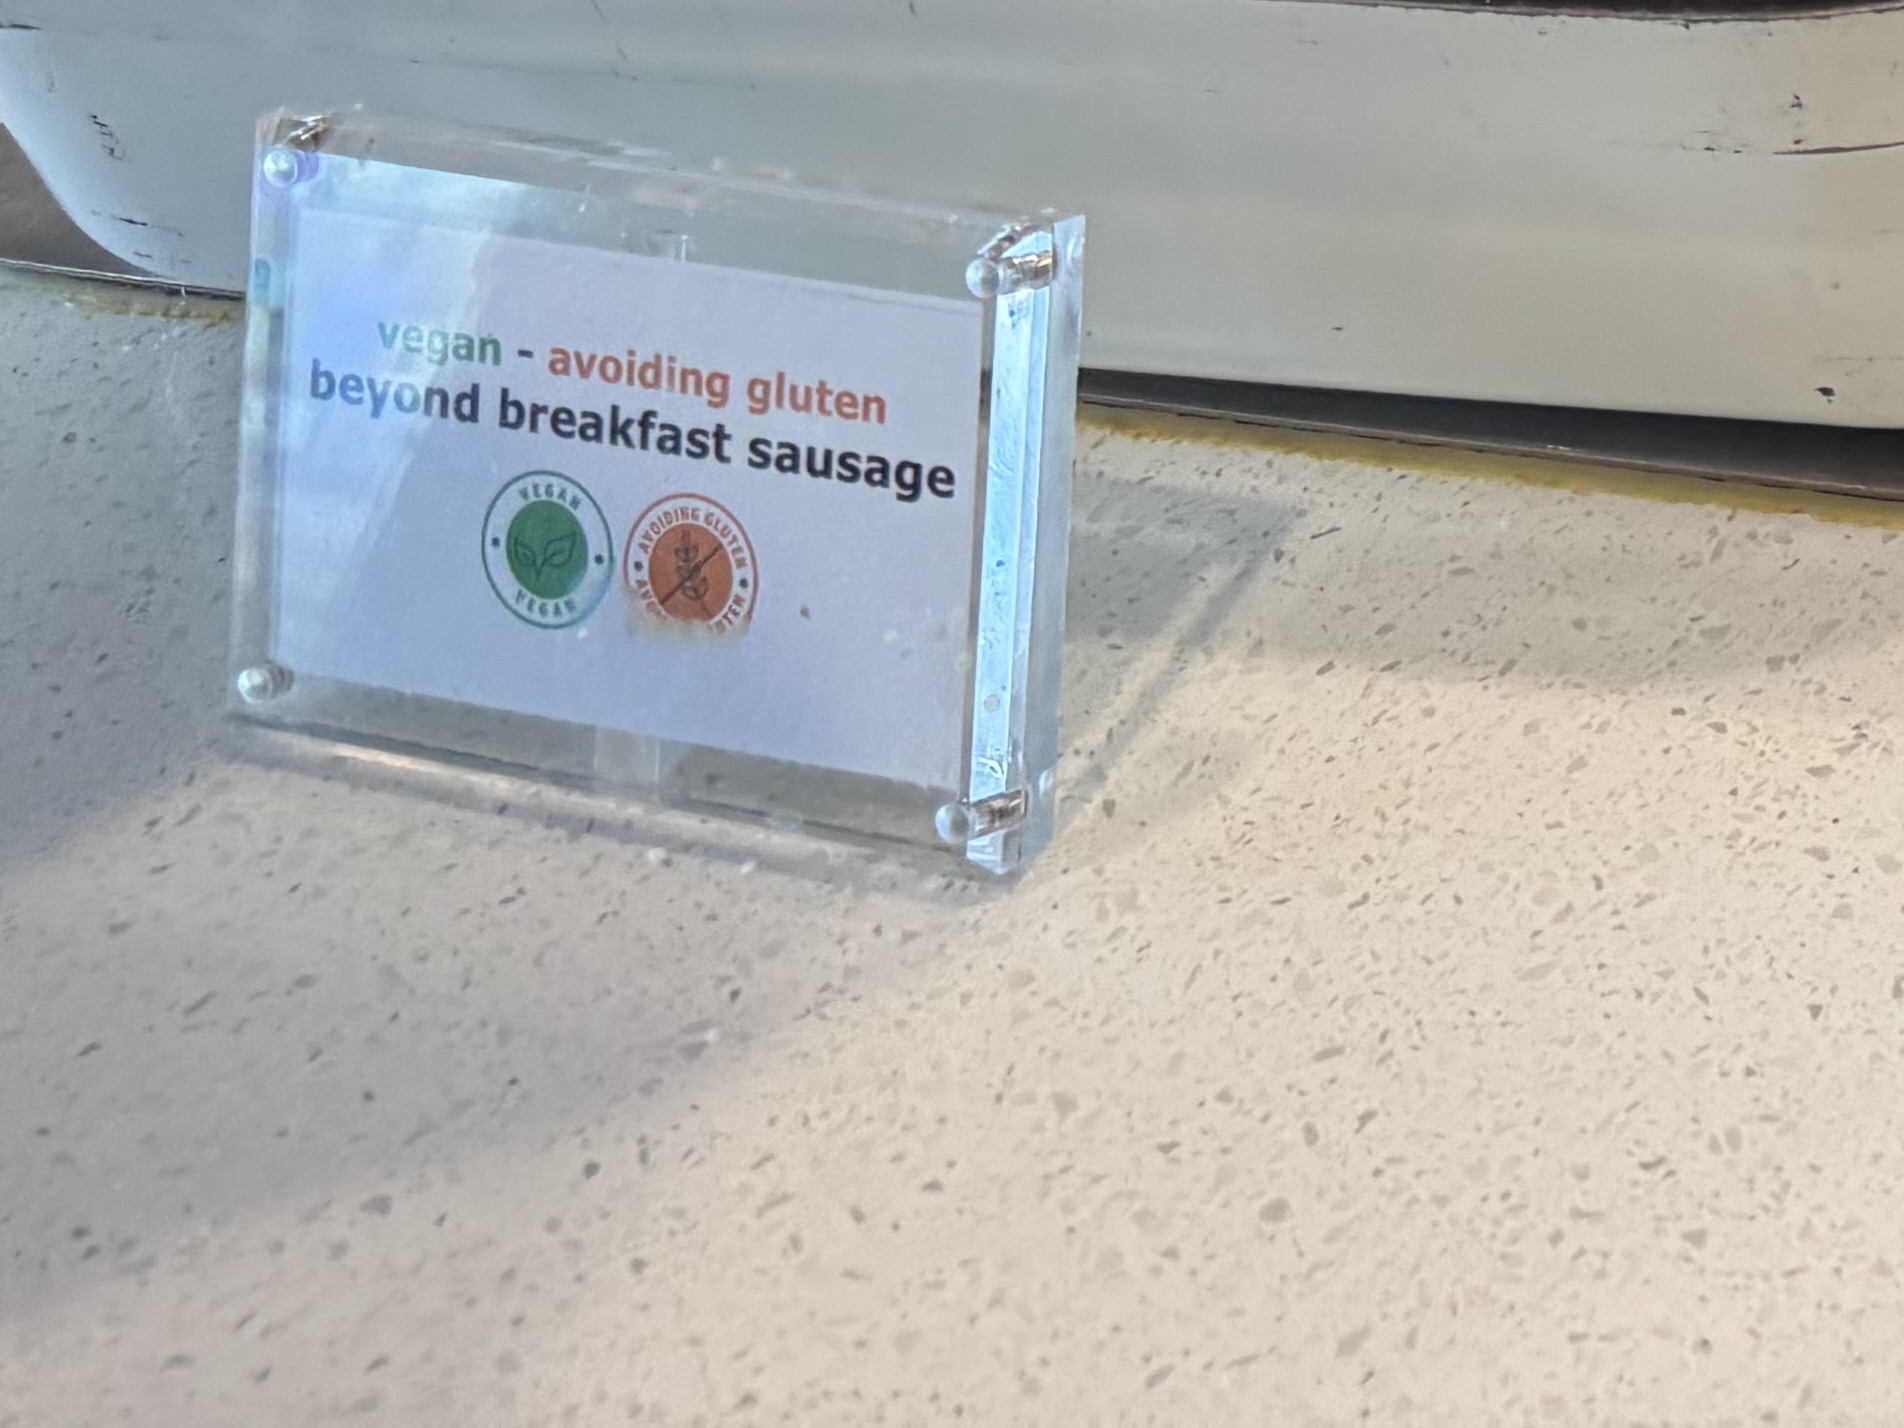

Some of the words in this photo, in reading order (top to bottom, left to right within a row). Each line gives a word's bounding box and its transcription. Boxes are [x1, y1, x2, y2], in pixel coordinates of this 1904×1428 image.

[378, 319, 501, 366] vegan
[547, 343, 730, 408] avoiding
[747, 369, 887, 425] gluten
[309, 359, 480, 423] beyond
[499, 386, 732, 464] breakfast
[747, 433, 955, 503] sausage
[517, 483, 582, 511] VEGAN
[637, 506, 702, 555] AVOIDING
[703, 509, 749, 570] GLUTEN
[515, 589, 577, 618] VEGAN
